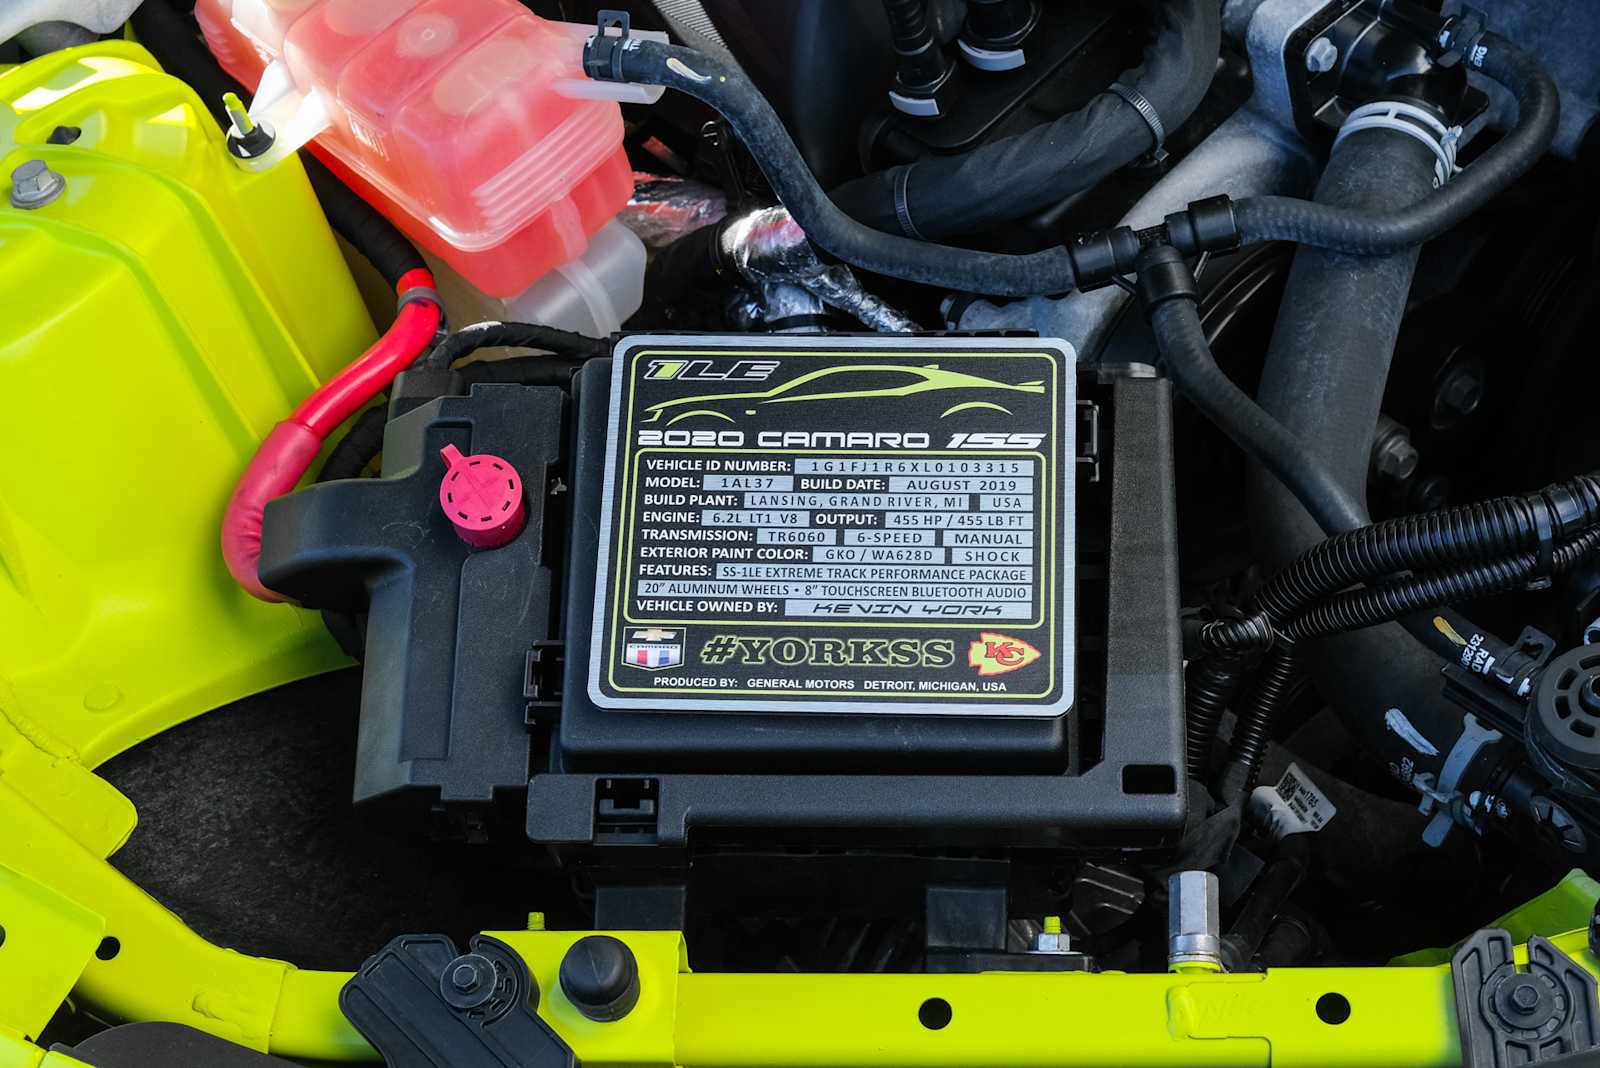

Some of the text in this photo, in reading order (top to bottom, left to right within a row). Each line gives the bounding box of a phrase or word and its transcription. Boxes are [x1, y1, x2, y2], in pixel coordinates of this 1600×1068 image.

[643, 359, 781, 381] 1LE
[637, 430, 1047, 449] 2020 CAMARO 1SS
[646, 459, 702, 472] VEHICLE
[705, 460, 721, 472] ID
[724, 460, 791, 472] NUMBER:
[645, 477, 1016, 491] MODEL: 1AL37 BUILD DATE: AUGUST 2019
[644, 494, 1022, 508] BUILD PLANT: LANSING, GRAND RIVER, MI USA
[643, 512, 700, 523] ENGINE:
[713, 513, 742, 524] 6.2L
[750, 513, 771, 524] LT1
[780, 514, 798, 524] V8
[815, 513, 878, 525] OUTPUT:
[893, 515, 919, 526] 455
[924, 515, 942, 526] HP
[958, 515, 983, 526] 455
[988, 515, 1004, 526] LB
[1009, 515, 1024, 526] FT
[641, 529, 1023, 545] TRANSMISSION: TR6060 6-SPEED MANUAL
[640, 547, 708, 559] EXTERIOR
[711, 547, 752, 559] PAINT
[756, 548, 809, 560] COLOR:
[872, 549, 933, 561] WA628D
[965, 550, 1020, 562] SHOCK
[639, 564, 1026, 581] FEATURES: SS-1LE EXTREME TRACK PERFORMANCE PACKAGE
[668, 583, 738, 594] ALUMINUM
[741, 584, 789, 595] WHEELS
[823, 585, 908, 597] TOUCHSCREEN
[911, 586, 983, 598] BLUETOOTH
[986, 587, 1026, 598] AUDIO
[636, 599, 1003, 616] VEHICLE OWNED BY: KEVIN YORK
[701, 634, 955, 668] #YORKSS
[1471, 647, 1490, 673] RAD
[653, 676, 717, 687] PRODUCED
[719, 677, 739, 688] BY:
[747, 678, 802, 689] GENERAL
[805, 679, 855, 690] MOTORS
[918, 681, 979, 693] MICHIGAN,
[982, 682, 1007, 692] USA
